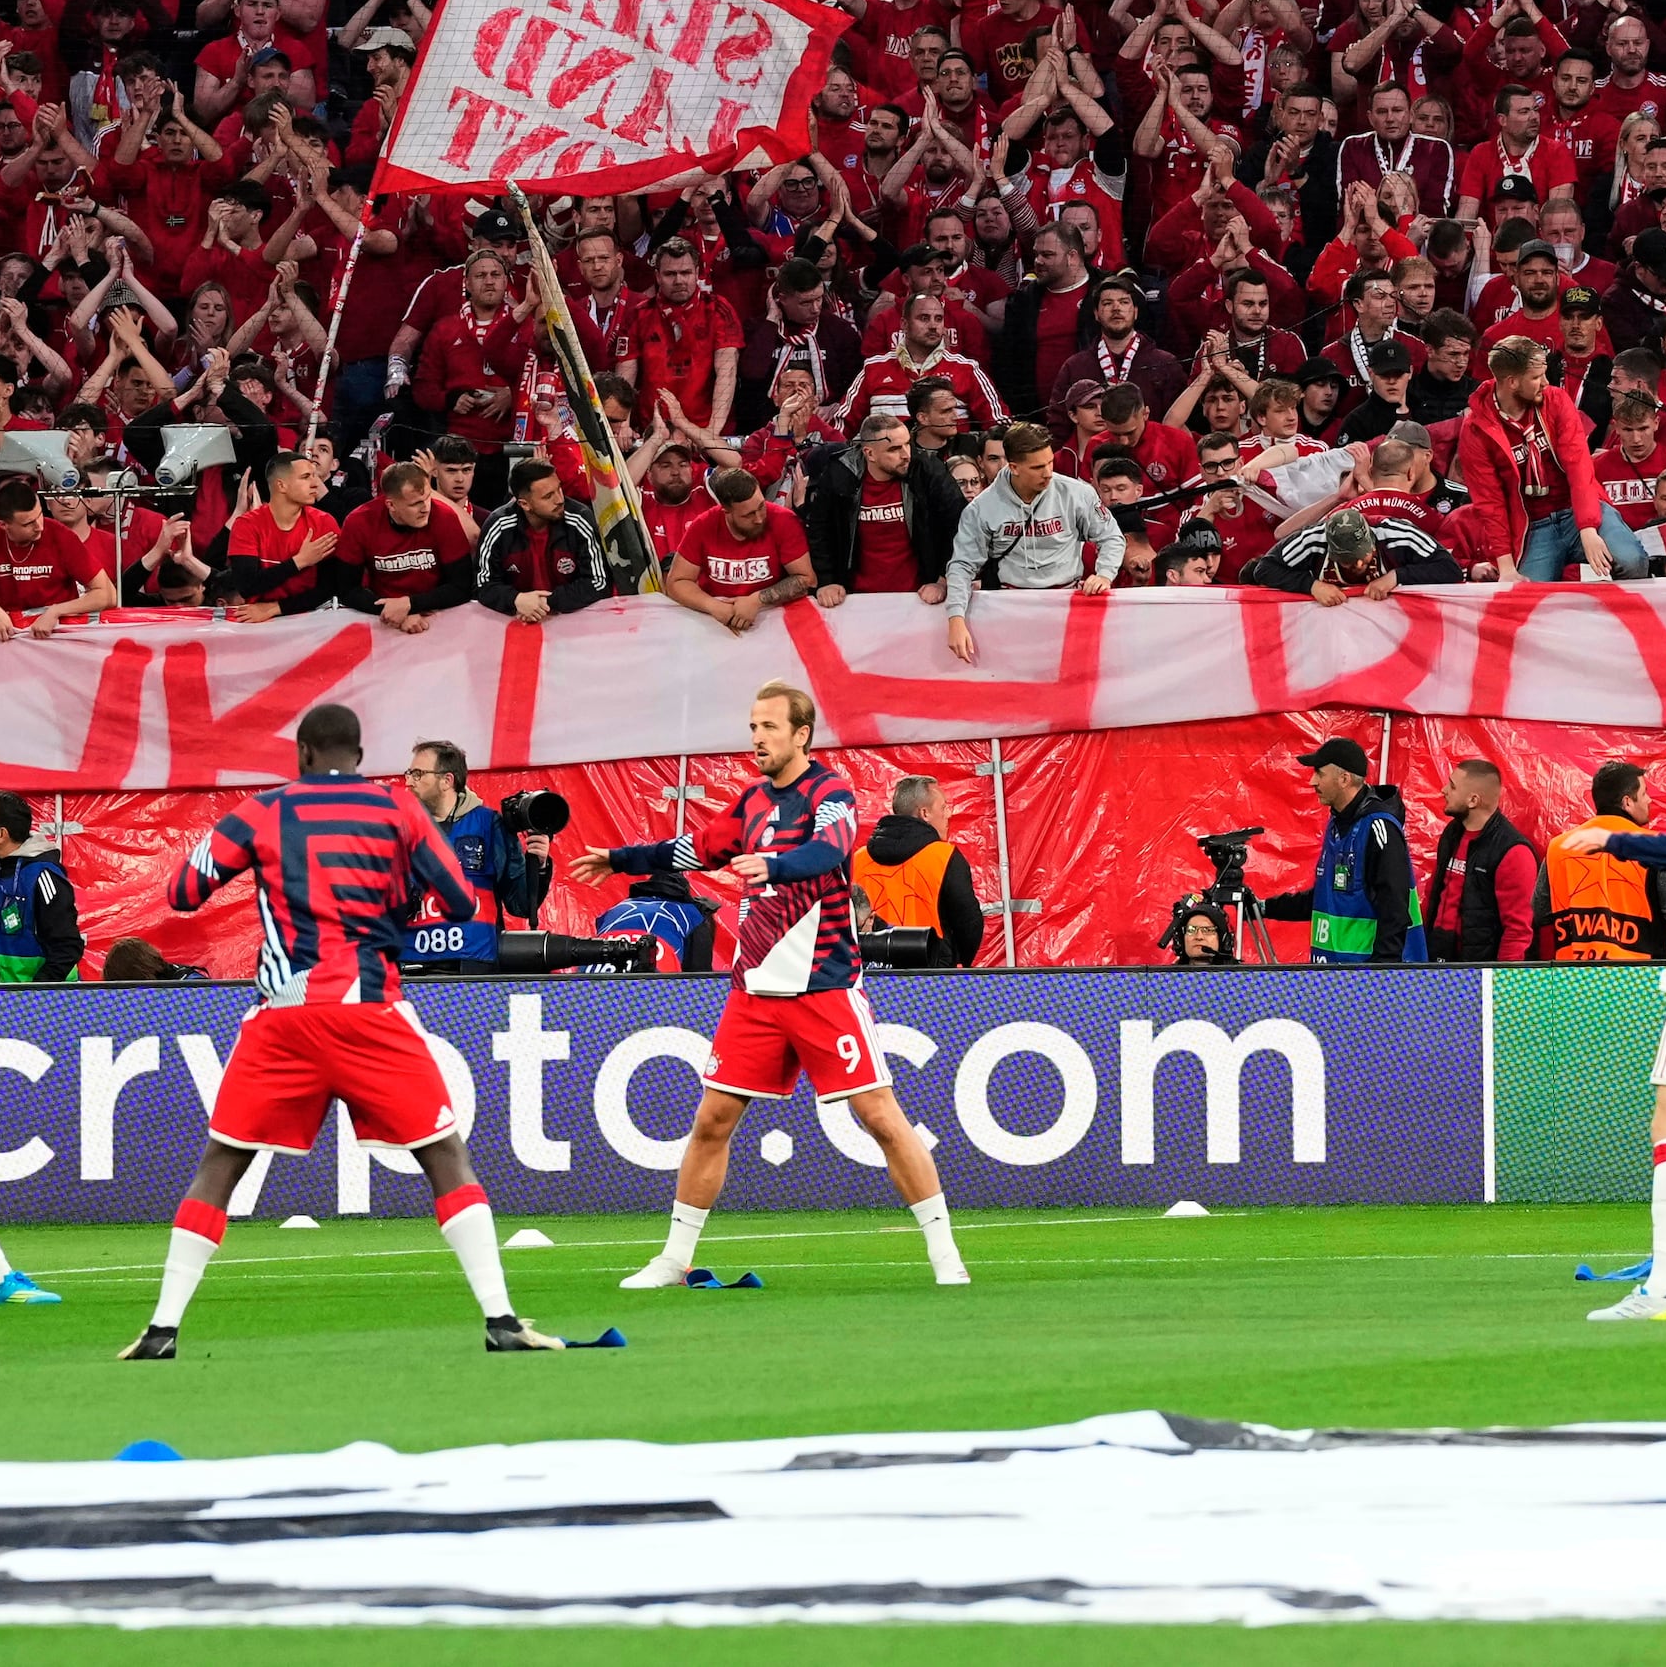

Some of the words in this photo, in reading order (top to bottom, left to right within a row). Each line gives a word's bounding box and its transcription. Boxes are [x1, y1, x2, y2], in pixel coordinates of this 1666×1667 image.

[1382, 497, 1427, 518] MÜNCHEN
[414, 926, 464, 954] 088
[1554, 918, 1639, 944] SWARD
[836, 1034, 861, 1075] 9
